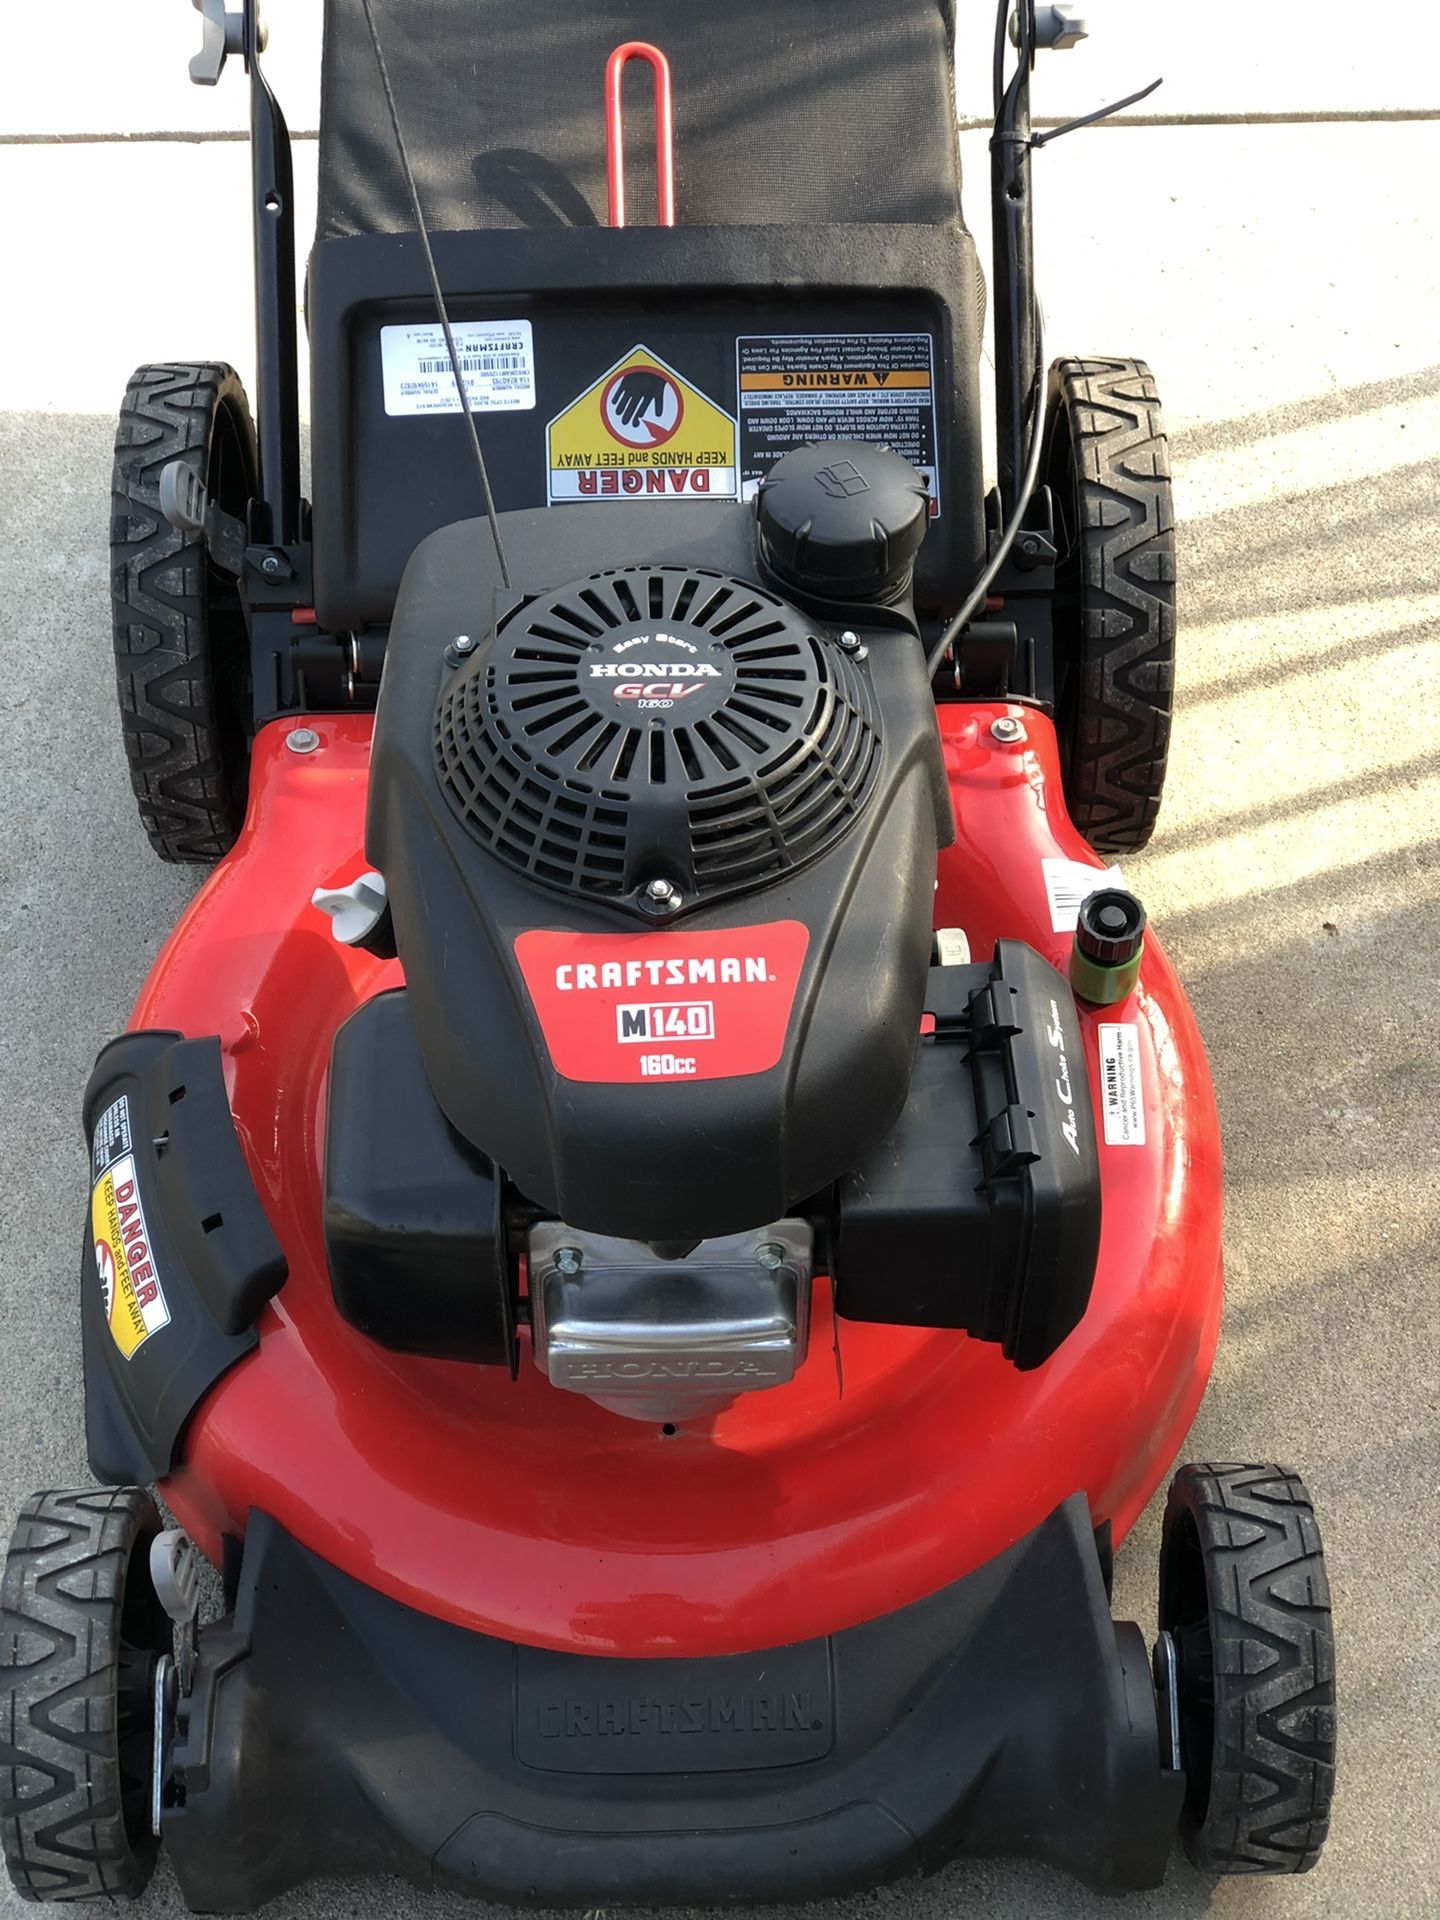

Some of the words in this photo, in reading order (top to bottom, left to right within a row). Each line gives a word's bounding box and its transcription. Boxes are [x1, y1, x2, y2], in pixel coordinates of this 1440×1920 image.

[466, 342, 523, 352] CRAFTSMAN
[783, 374, 868, 386] WARNING
[557, 453, 592, 466] AWAY
[595, 453, 624, 466] FEET
[628, 453, 648, 465] and
[652, 452, 692, 465] HANDS
[696, 452, 726, 464] KEEP
[578, 470, 709, 494] DANGER
[656, 634, 698, 653] Start
[590, 664, 721, 677] HONDA
[612, 682, 706, 699] GCV
[638, 698, 674, 708] 160
[622, 1006, 708, 1037] M140
[1047, 1000, 1064, 1051] System
[640, 1054, 696, 1076] 160cc
[1117, 1052, 1127, 1098] Reproductive
[1056, 1055, 1072, 1104] Choke
[1106, 1058, 1118, 1106] WARNING
[120, 1122, 128, 1150] OPERATE
[1062, 1109, 1080, 1155] Auto
[1122, 1115, 1130, 1140] Cancer
[103, 1178, 114, 1207] KEEP
[107, 1210, 122, 1248] HANDS
[115, 1180, 158, 1308] DANGER
[115, 1249, 126, 1270] and
[118, 1270, 133, 1298] FEET
[127, 1303, 145, 1336] AWAY
[568, 1361, 776, 1379] HONDA
